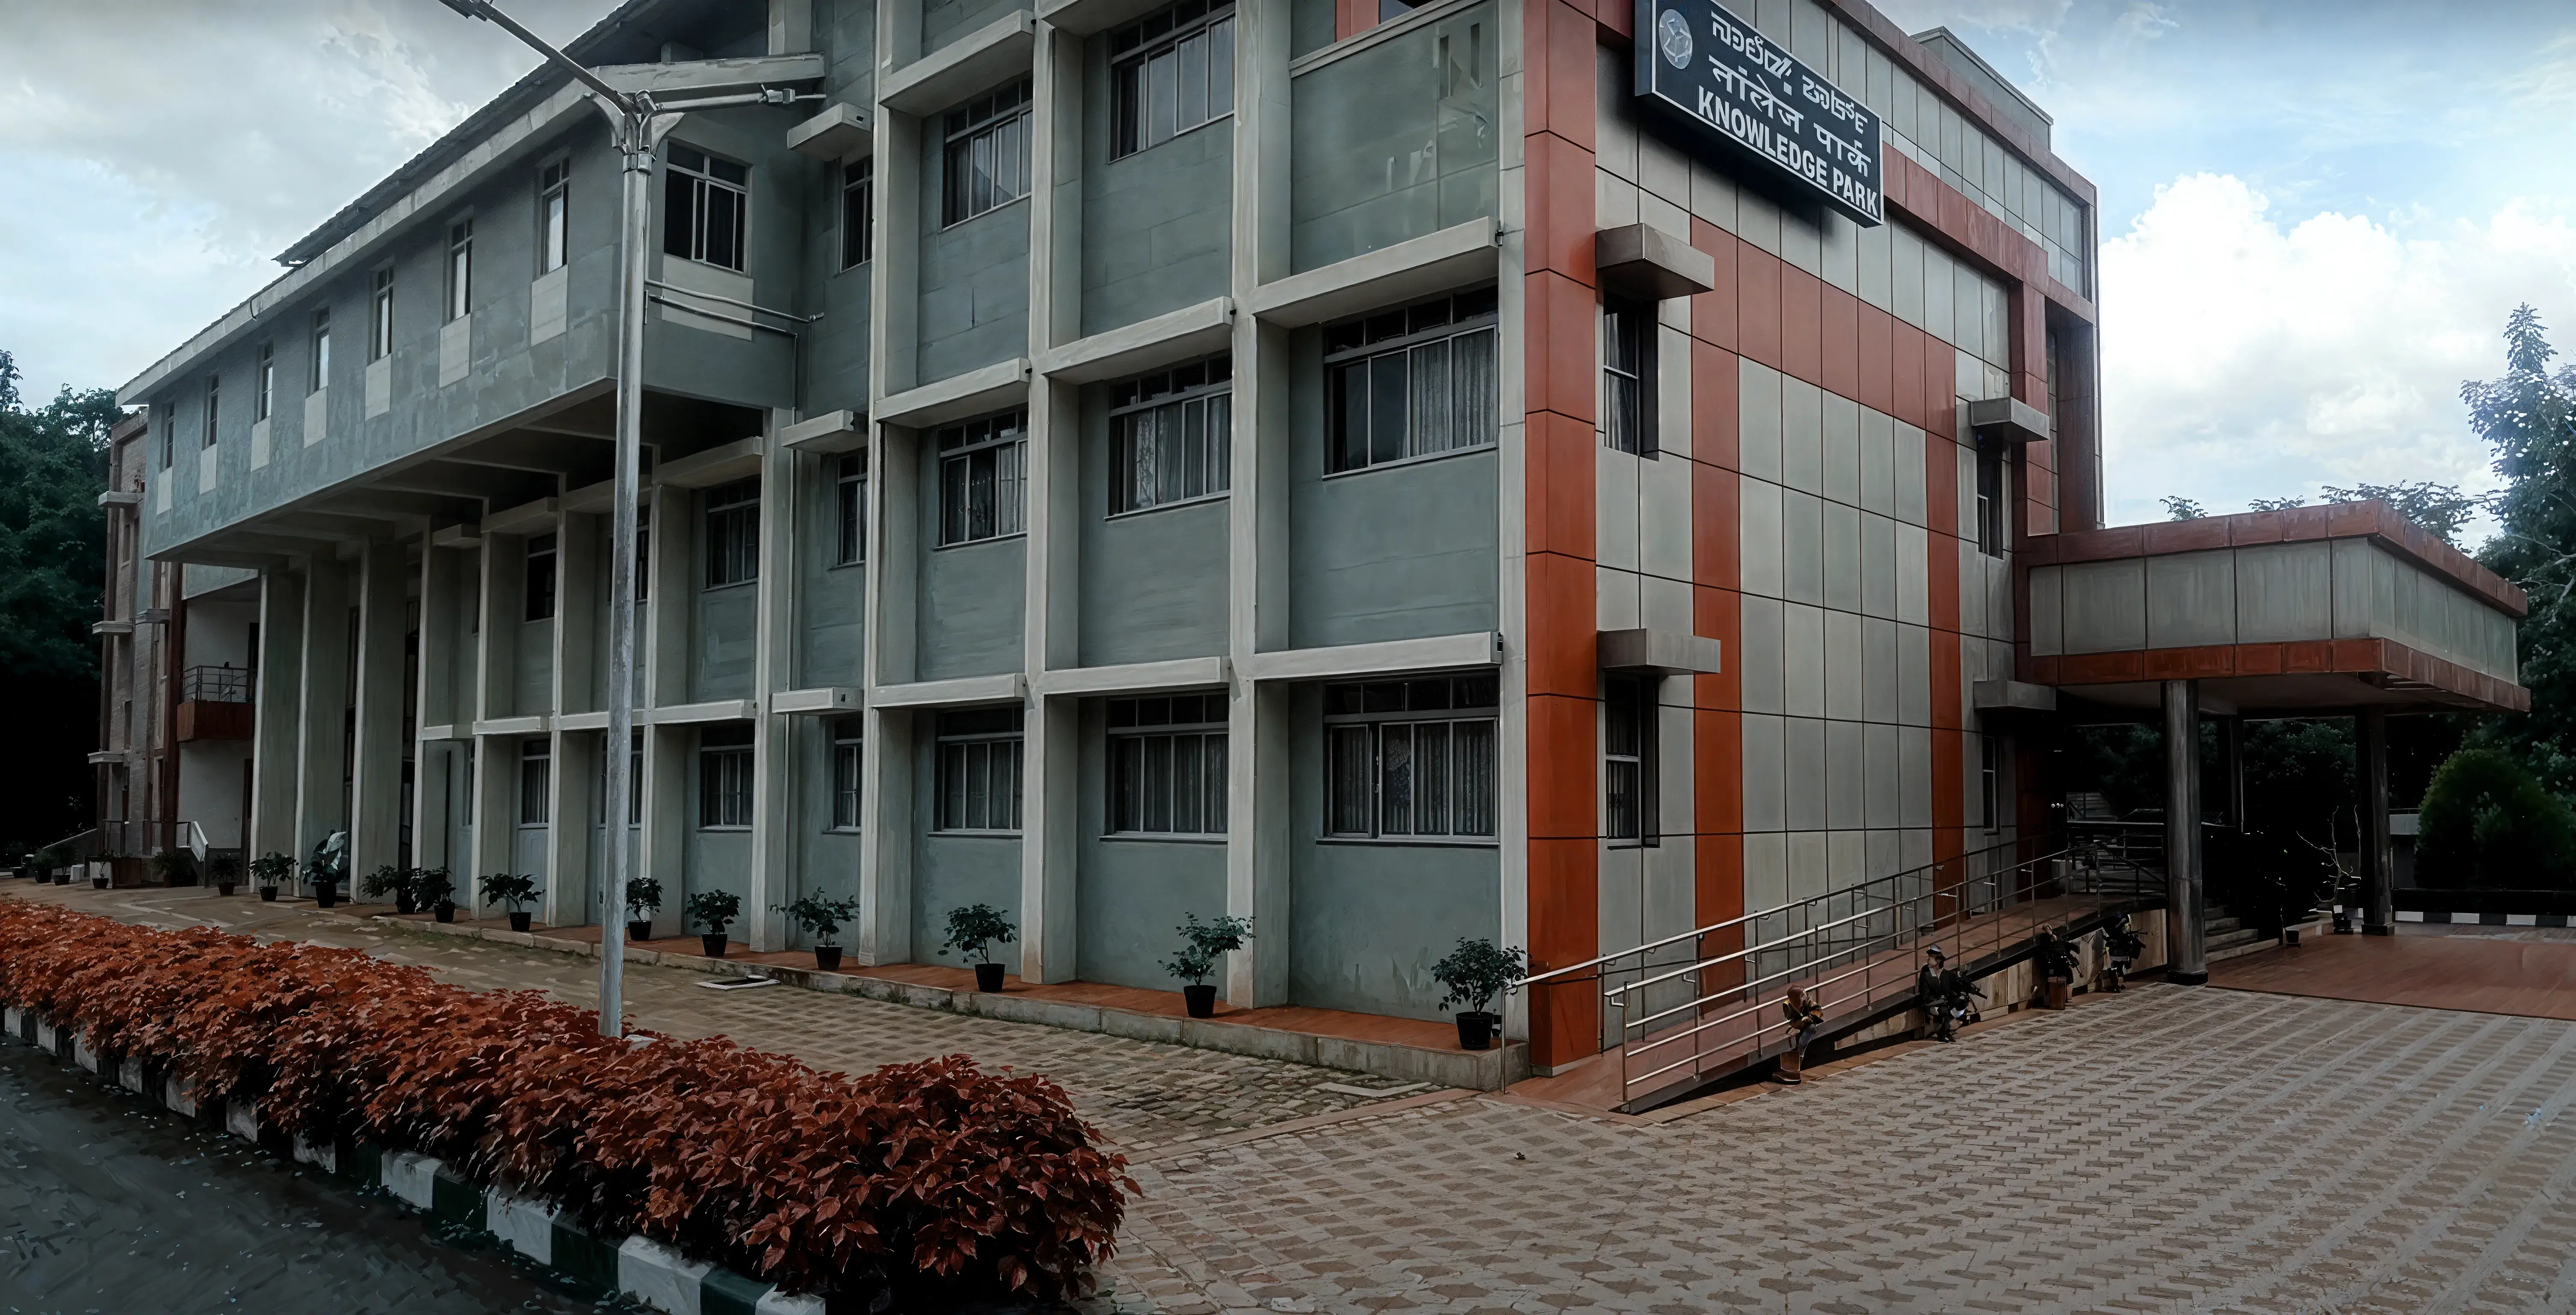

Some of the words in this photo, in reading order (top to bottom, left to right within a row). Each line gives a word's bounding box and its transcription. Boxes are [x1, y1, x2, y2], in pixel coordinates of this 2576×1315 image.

[1699, 85, 1827, 187] KNOWLEDGE
[1833, 167, 1878, 217] PARK
[1813, 122, 1871, 178] पार्क
